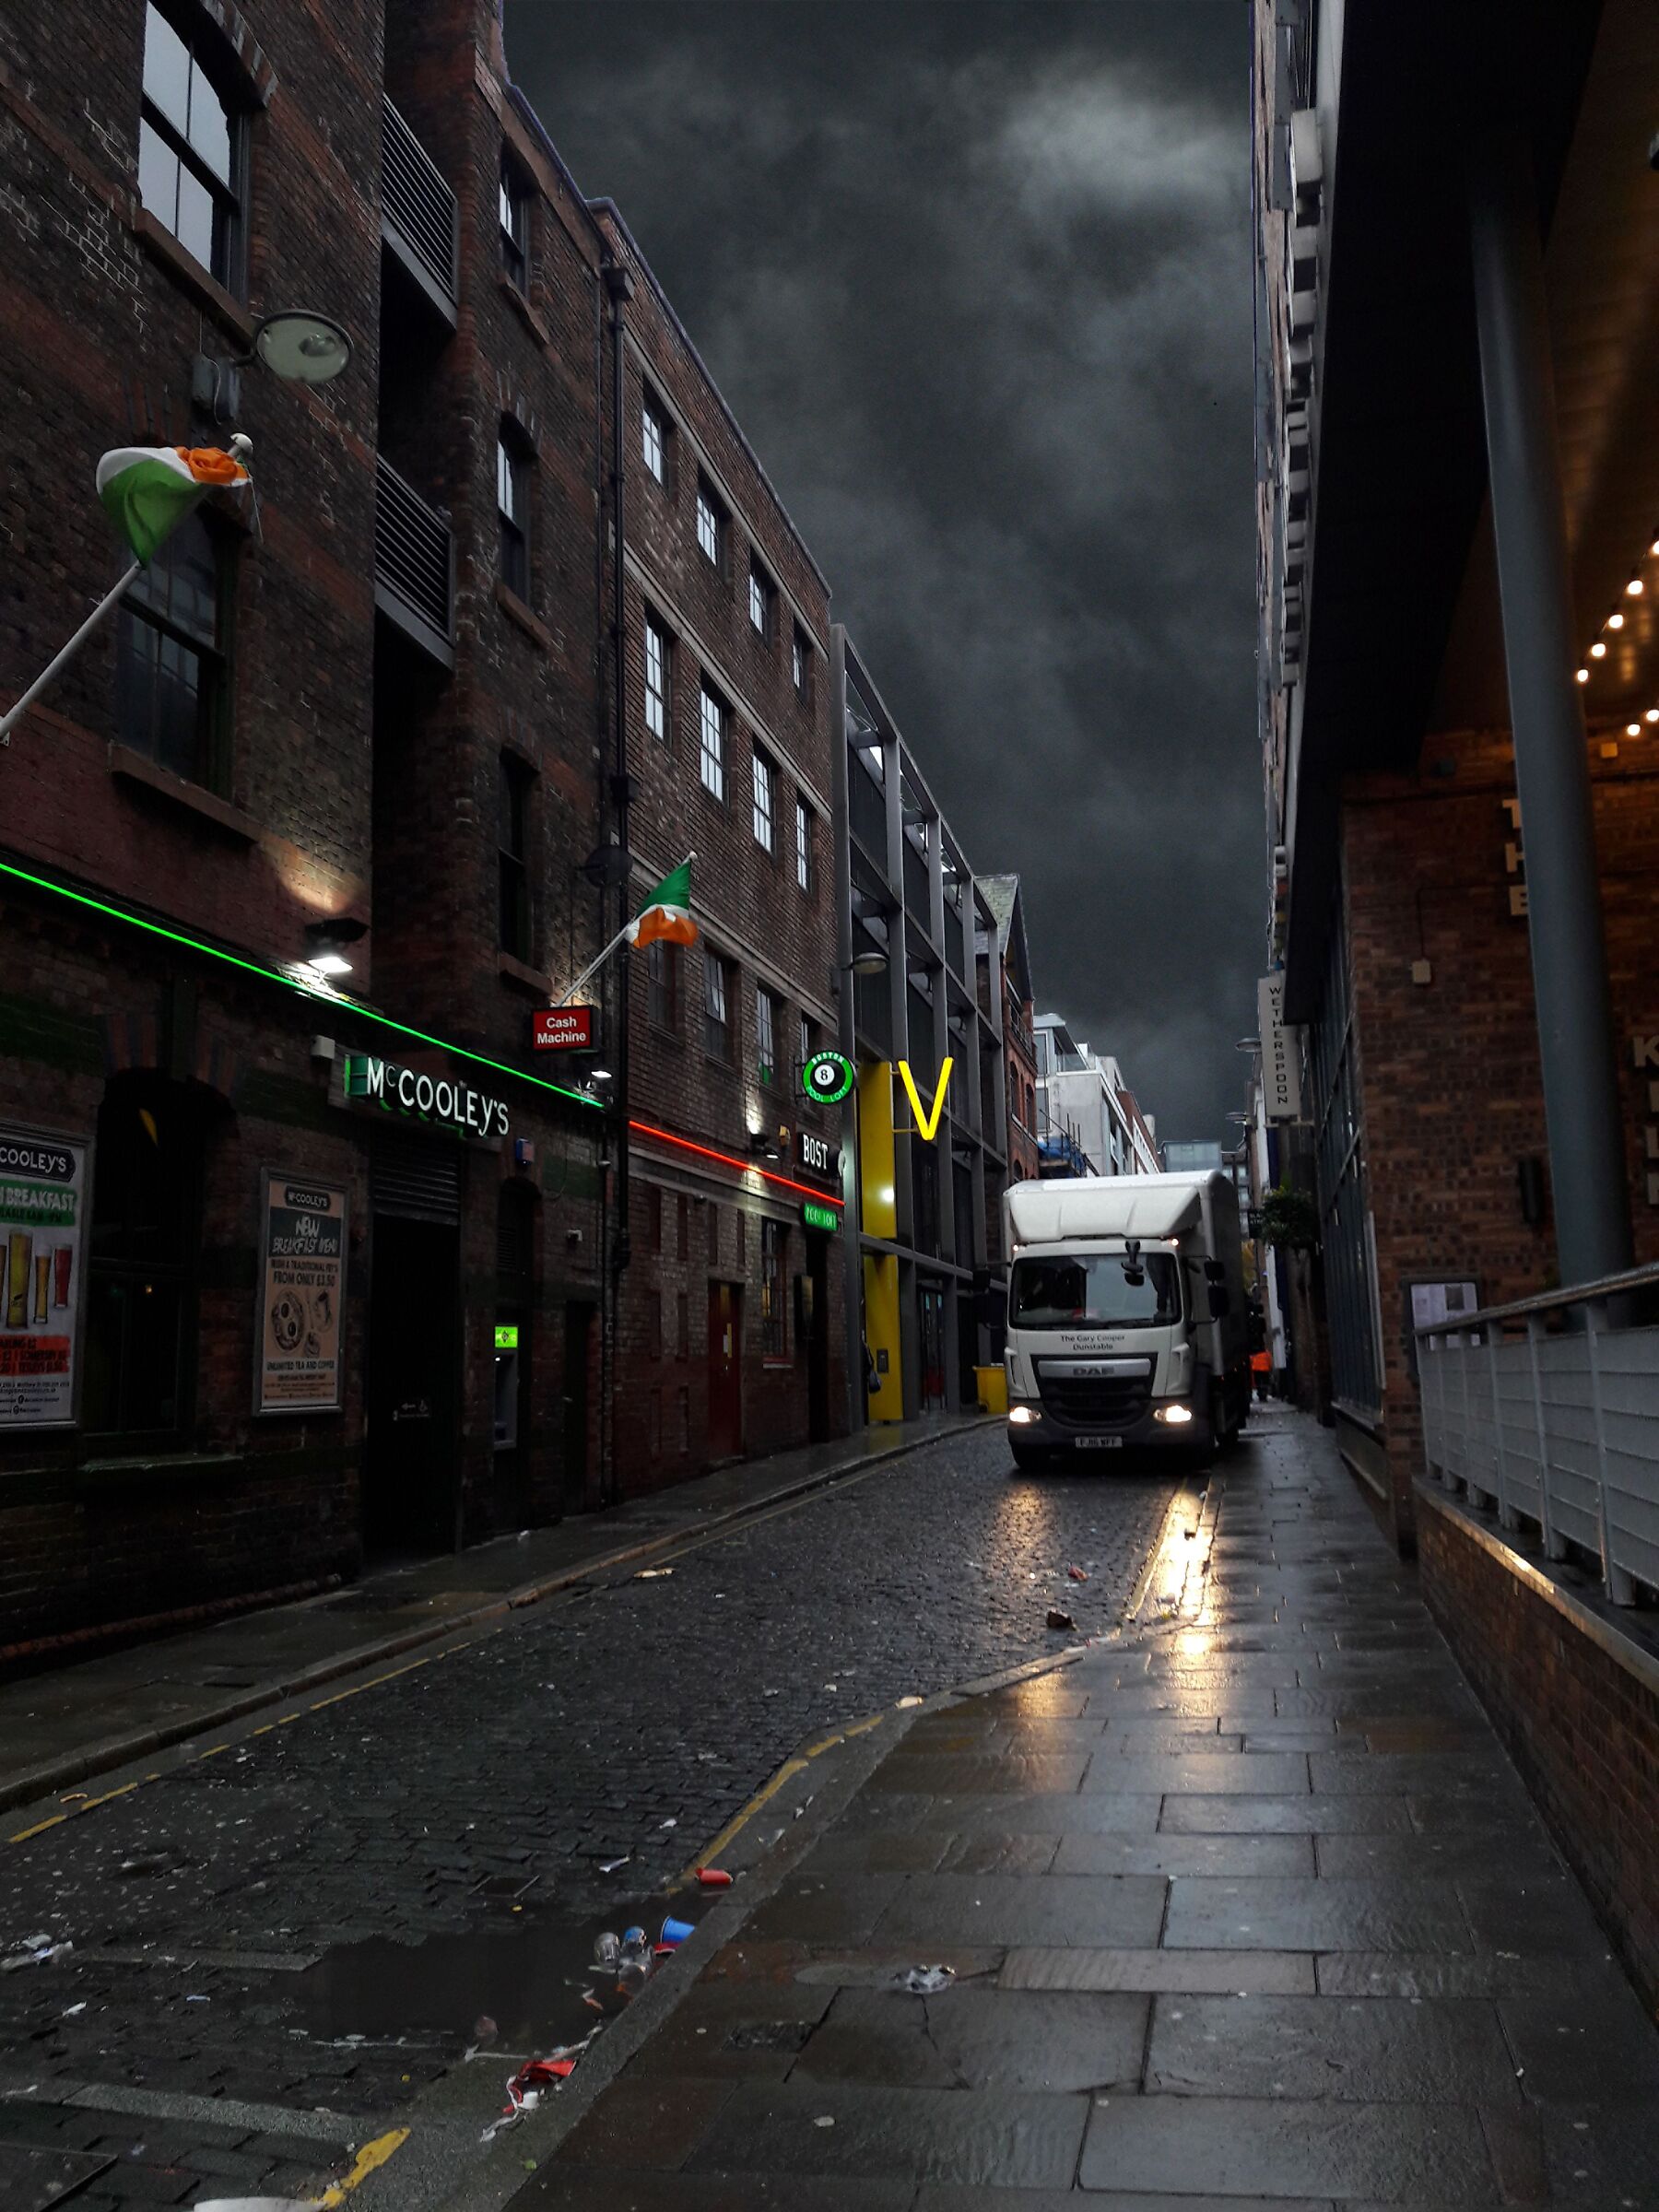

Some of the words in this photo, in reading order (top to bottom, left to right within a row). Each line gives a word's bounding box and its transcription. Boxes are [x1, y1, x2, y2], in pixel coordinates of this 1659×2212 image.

[546, 1017, 577, 1029] Cash
[537, 1030, 587, 1044] Machine
[1269, 986, 1288, 1104] WETHERSPOON
[811, 1052, 844, 1065] BOSTON
[820, 1069, 829, 1081] 8
[806, 1086, 824, 1102] POOL
[830, 1086, 847, 1102] LOFT
[6, 1187, 75, 1211] BREAKFAST
[295, 1216, 320, 1238] NEW
[274, 1271, 295, 1284] FROM
[296, 1272, 315, 1286] ONLY
[1061, 1335, 1075, 1343] The
[1077, 1335, 1095, 1343] Gary
[1073, 1343, 1113, 1351] Dunstable
[1073, 1368, 1114, 1376] DAF
